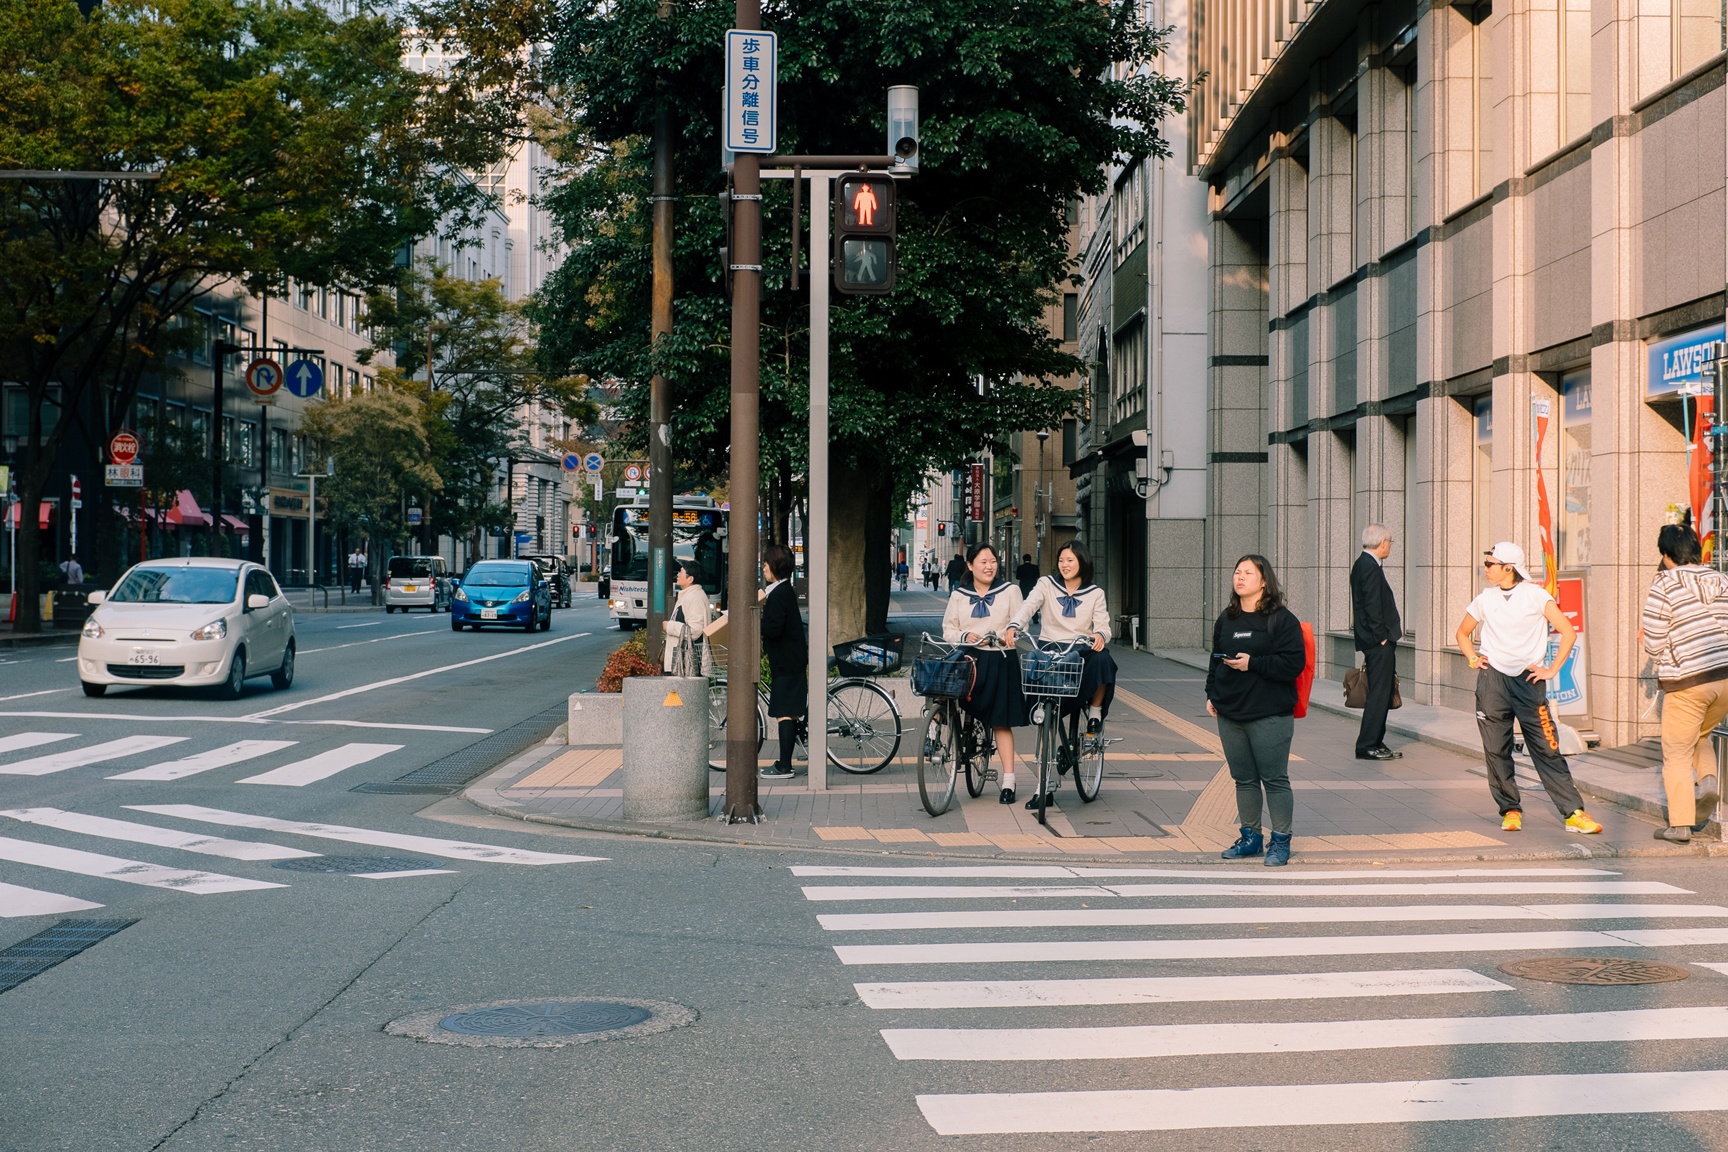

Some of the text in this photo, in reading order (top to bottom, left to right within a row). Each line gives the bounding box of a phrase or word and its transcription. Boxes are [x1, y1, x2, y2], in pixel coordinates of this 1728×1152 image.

[742, 38, 760, 144] 歩車分離信号
[114, 442, 136, 453] 消火栓
[135, 655, 158, 664] 65-96
[1538, 704, 1558, 750] umbro
